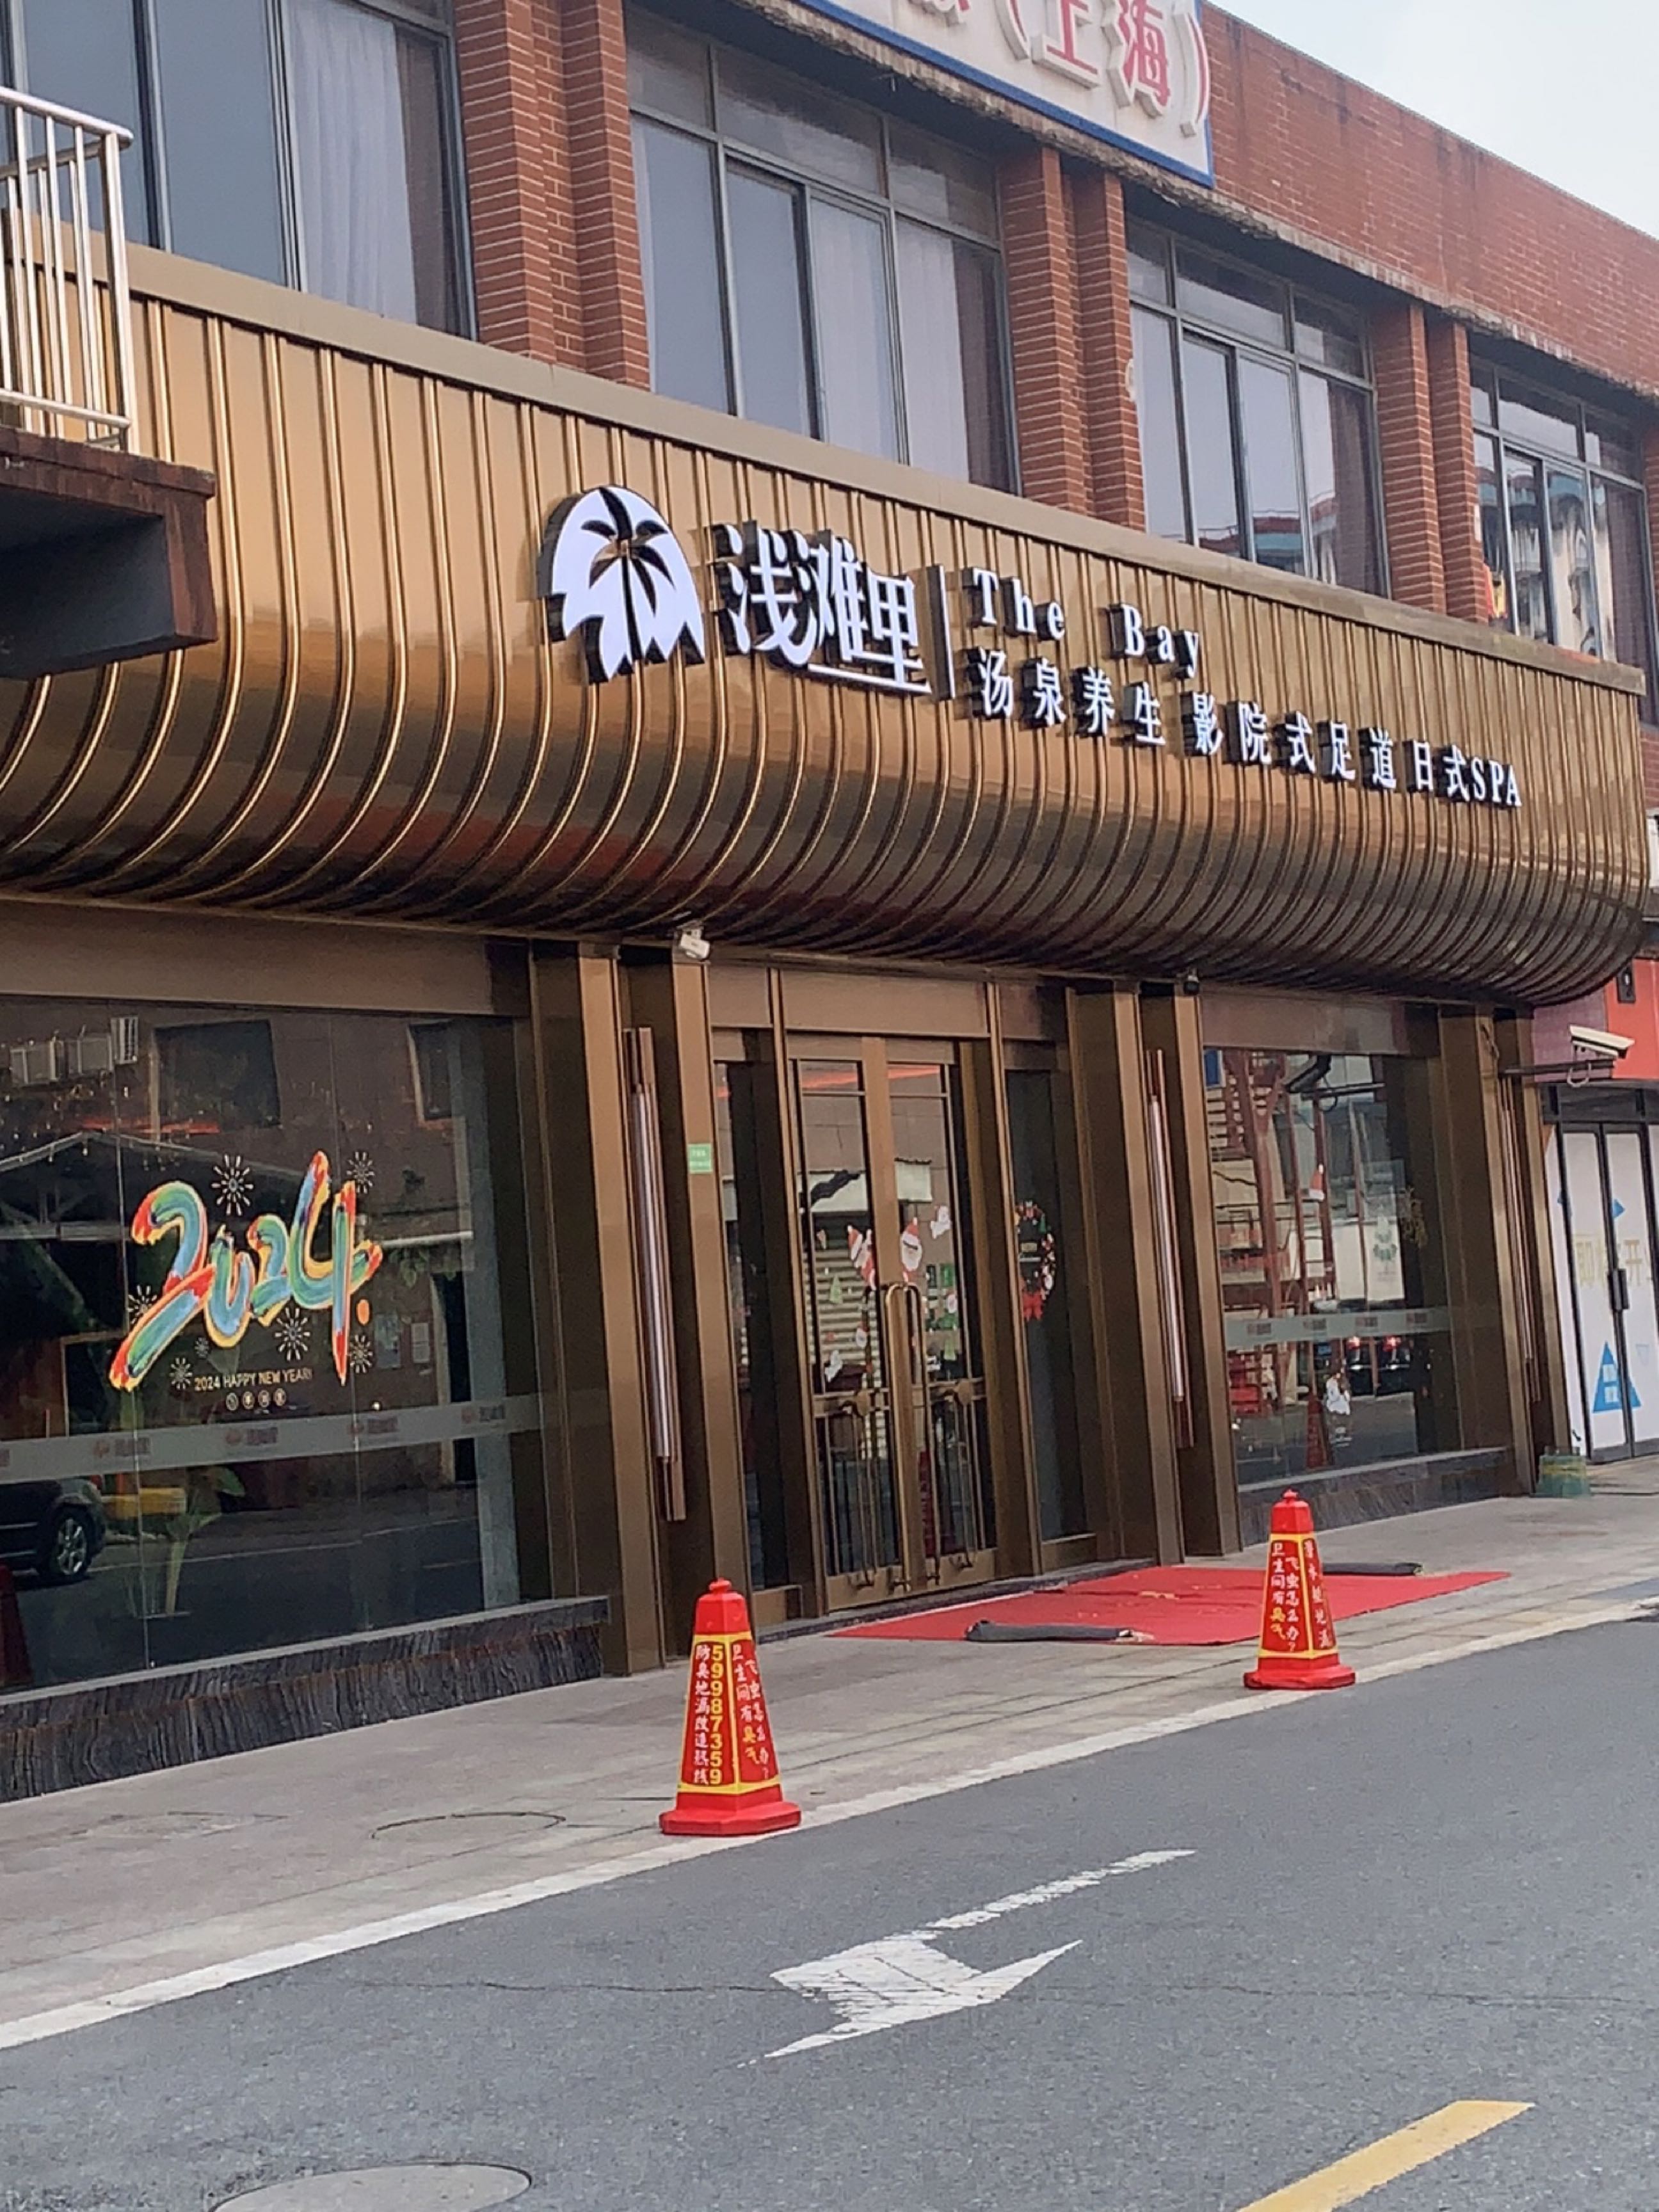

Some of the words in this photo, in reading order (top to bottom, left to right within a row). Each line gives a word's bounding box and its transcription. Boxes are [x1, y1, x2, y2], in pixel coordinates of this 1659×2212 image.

[725, 524, 932, 694] 浅滩里
[974, 568, 1065, 639] The
[1121, 603, 1199, 678] Bay
[109, 1151, 383, 1391] 2024
[194, 1377, 221, 1391] 2024
[225, 1373, 256, 1388] HAPPY
[259, 1370, 280, 1384] NEW
[710, 1645, 724, 1784] 59987359
